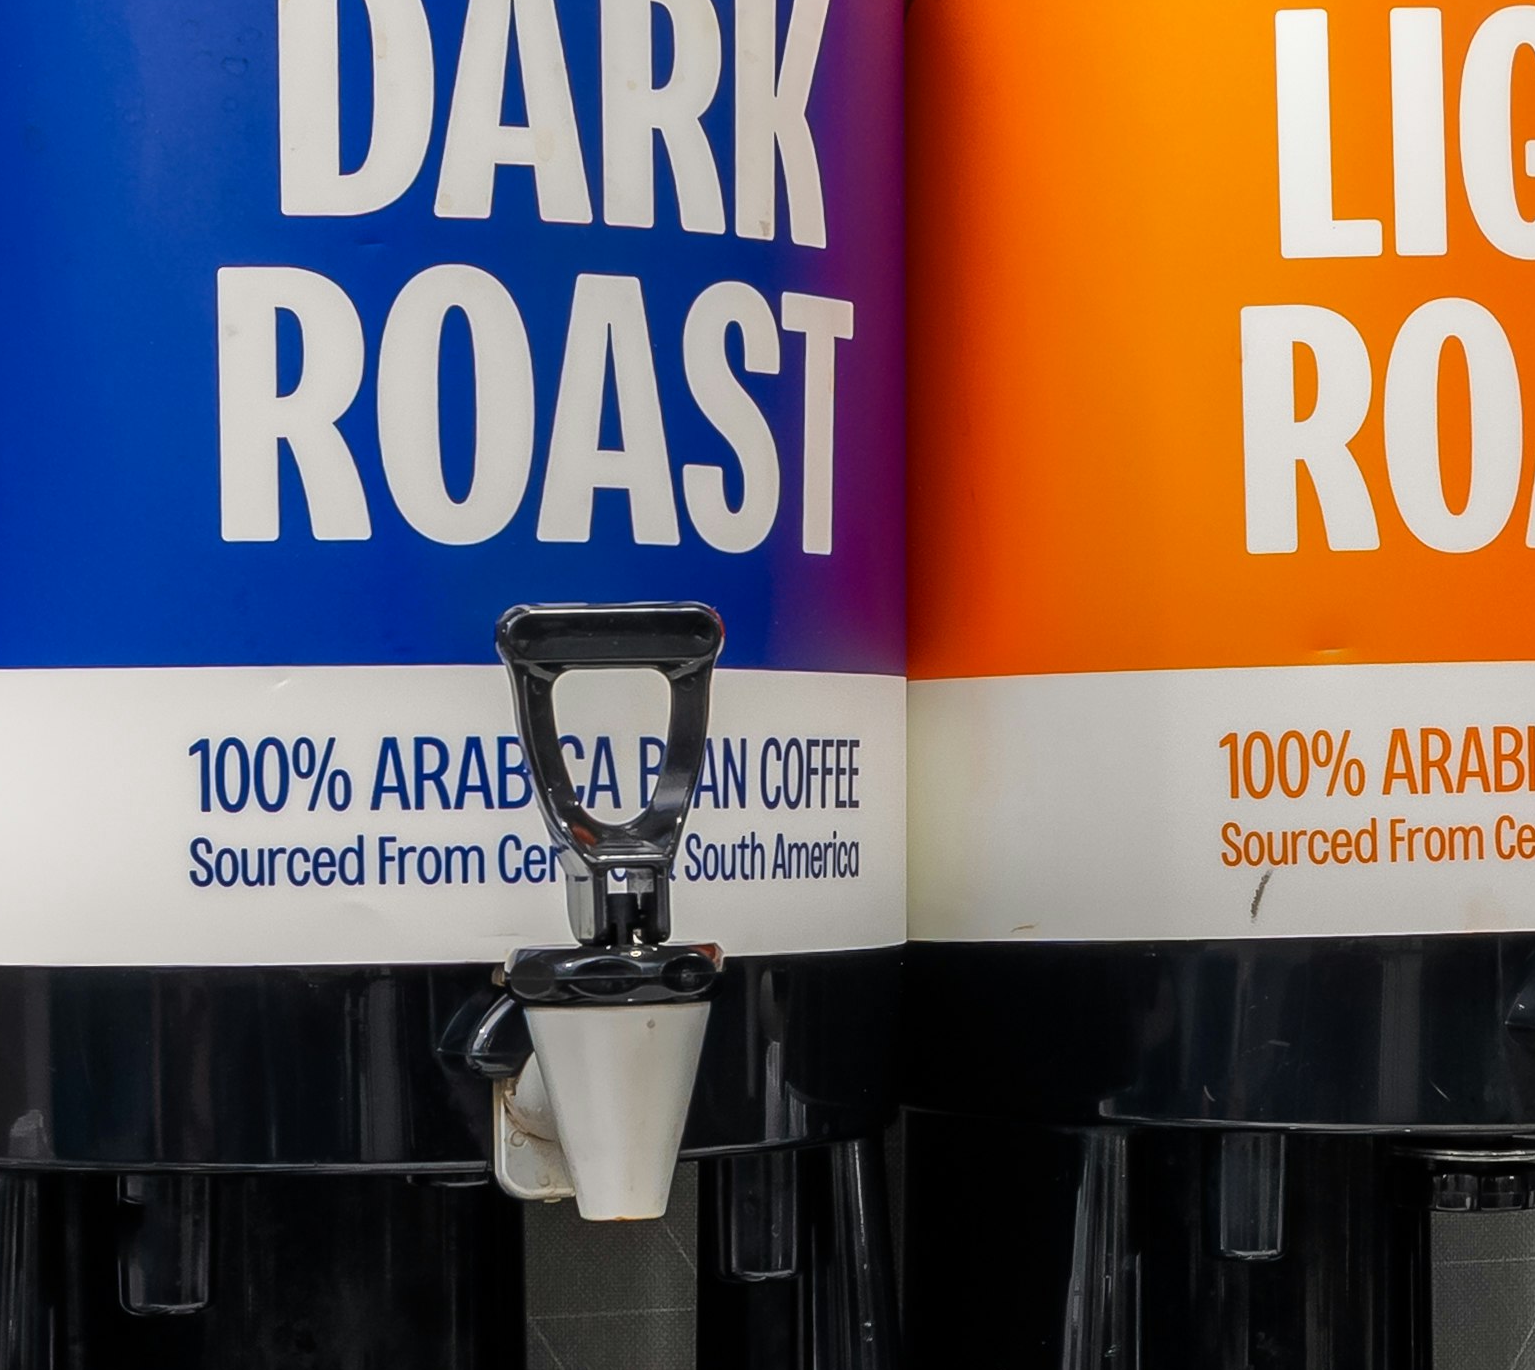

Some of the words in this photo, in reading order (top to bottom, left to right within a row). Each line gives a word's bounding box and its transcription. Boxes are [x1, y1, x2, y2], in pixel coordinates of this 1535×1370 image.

[217, 263, 853, 555] ROAST
[188, 736, 353, 814] 100%
[371, 734, 622, 812] ARABCA
[639, 736, 747, 809] BAN
[760, 737, 859, 810] COFFEE
[1219, 729, 1366, 799] 100%
[189, 833, 365, 887] Sourced
[379, 834, 485, 885] From
[685, 831, 765, 882] South
[772, 832, 859, 880] America
[1221, 817, 1378, 867] Sourced
[1390, 817, 1484, 863] From
